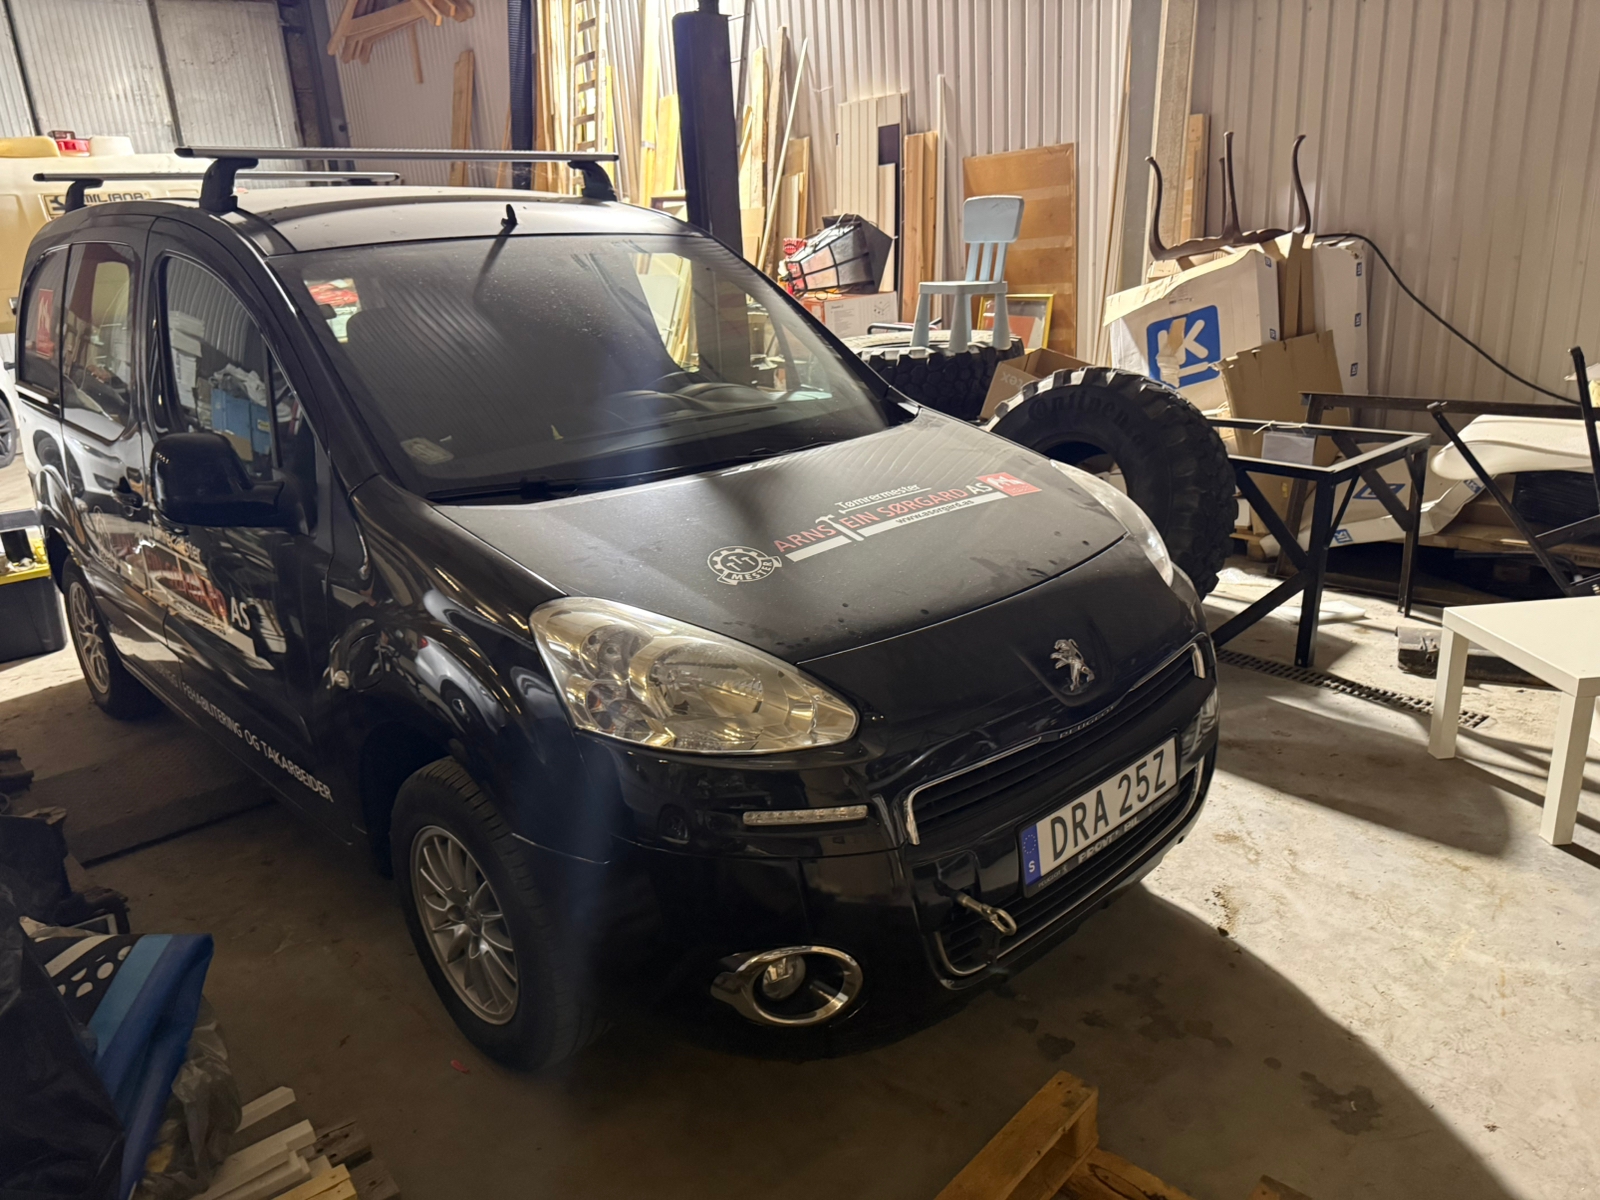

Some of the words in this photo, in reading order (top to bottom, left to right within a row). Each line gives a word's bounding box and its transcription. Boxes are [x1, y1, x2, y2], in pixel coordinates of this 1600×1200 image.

[834, 484, 920, 510] Tømrermester
[876, 488, 969, 518] SØRGARD
[965, 482, 993, 495] AS
[731, 560, 774, 582] MESTER
[231, 596, 251, 632] AS
[244, 729, 261, 751] OG
[260, 740, 334, 803] TAKARBEIDER
[1050, 788, 1110, 862] DRA
[1117, 748, 1167, 818] 25Z
[1028, 860, 1036, 873] S
